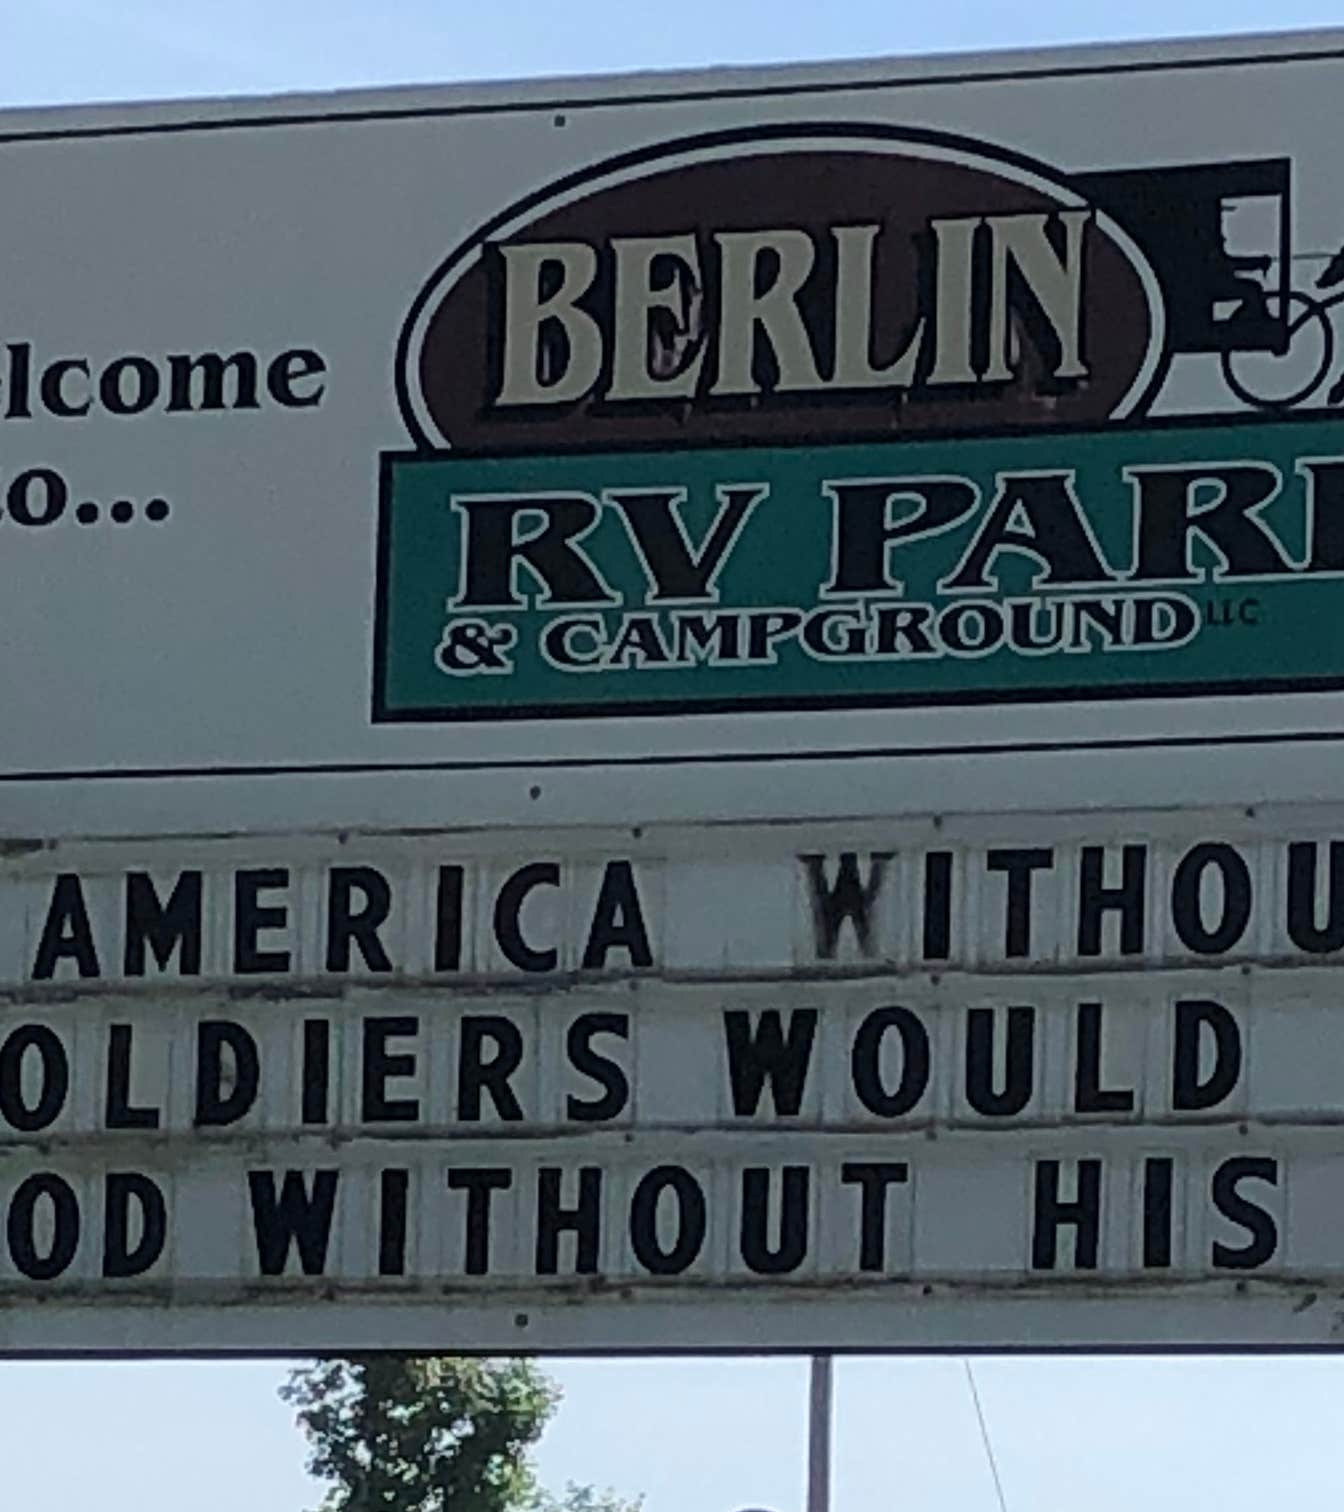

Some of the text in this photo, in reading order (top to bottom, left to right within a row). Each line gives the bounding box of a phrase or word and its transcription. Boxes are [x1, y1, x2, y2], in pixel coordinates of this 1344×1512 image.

[492, 207, 1094, 407] BERLIN
[449, 481, 769, 610] RV
[435, 593, 1258, 672] & CAMPGROUND LLC
[31, 859, 654, 981] AMERICA
[724, 1000, 1242, 1118] WOULD
[249, 1162, 909, 1280] WITHOUT
[1032, 1156, 1278, 1270] HIS
